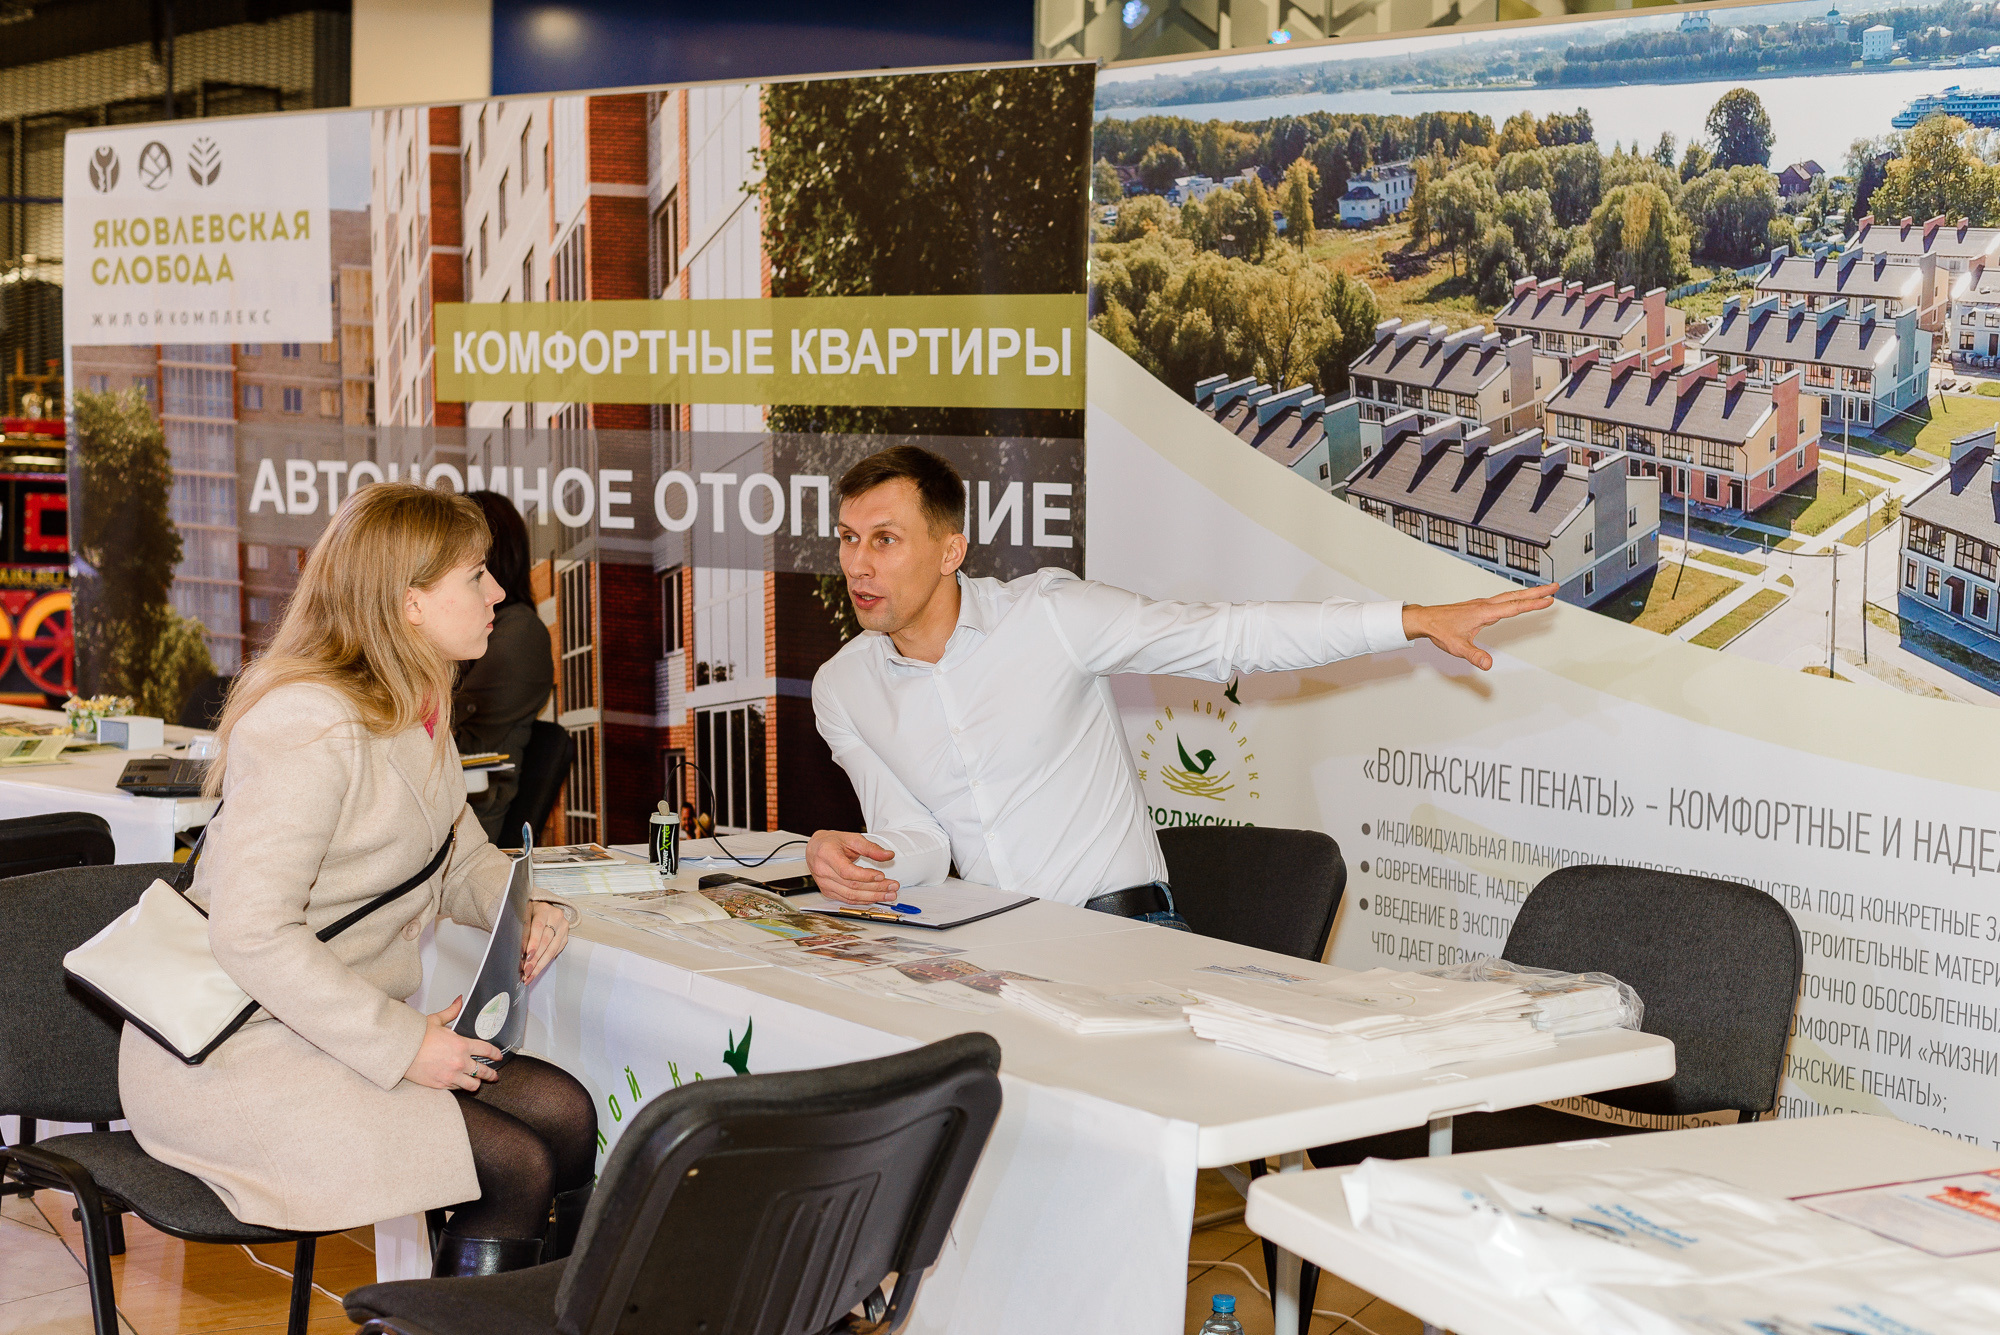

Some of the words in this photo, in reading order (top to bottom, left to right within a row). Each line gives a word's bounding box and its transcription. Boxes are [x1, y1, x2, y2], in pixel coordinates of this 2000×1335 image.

[93, 209, 311, 249] ЯКОВЛЕВСКАЯ
[91, 253, 235, 286] СЛОБОДА
[453, 328, 775, 375] КОМФОРТНЫЕ
[790, 326, 1073, 377] КВАРТИРЫ
[653, 469, 1074, 549] ОТОПИЕ
[1362, 747, 1512, 803] «ВОЛЖСКИЕ
[1520, 767, 1635, 818] ПЕНАТЫ»
[1668, 787, 1873, 855] КОМФОРТНЫЕ
[1882, 815, 1902, 859] И
[1913, 819, 2000, 878] НАДЕ
[1376, 819, 1507, 862] ИНДИВИДУАЛЬНАЯ
[1375, 856, 1481, 899] СОВРЕМЕННЫЕ,
[1374, 894, 1446, 929] ВВЕДЕНИЕ
[1449, 908, 1459, 931] В
[1462, 910, 1516, 940] ЭКСПЛ
[1818, 889, 1854, 922] ПОД
[1860, 895, 1981, 939] КОНКРЕТНЫЕ
[1985, 916, 2000, 943] З
[1371, 930, 1395, 956] ЧТО
[1398, 936, 1435, 963] ДАЕТ
[1798, 973, 1856, 1005] ТОЧНО
[1862, 984, 2000, 1034] ОБОСОБЛЕННЫ
[1876, 1029, 1912, 1060] ПРИ
[1917, 1038, 1998, 1078] «ЖИЗНИ
[1861, 1069, 1948, 1114] ПЕНАТЫ»;
